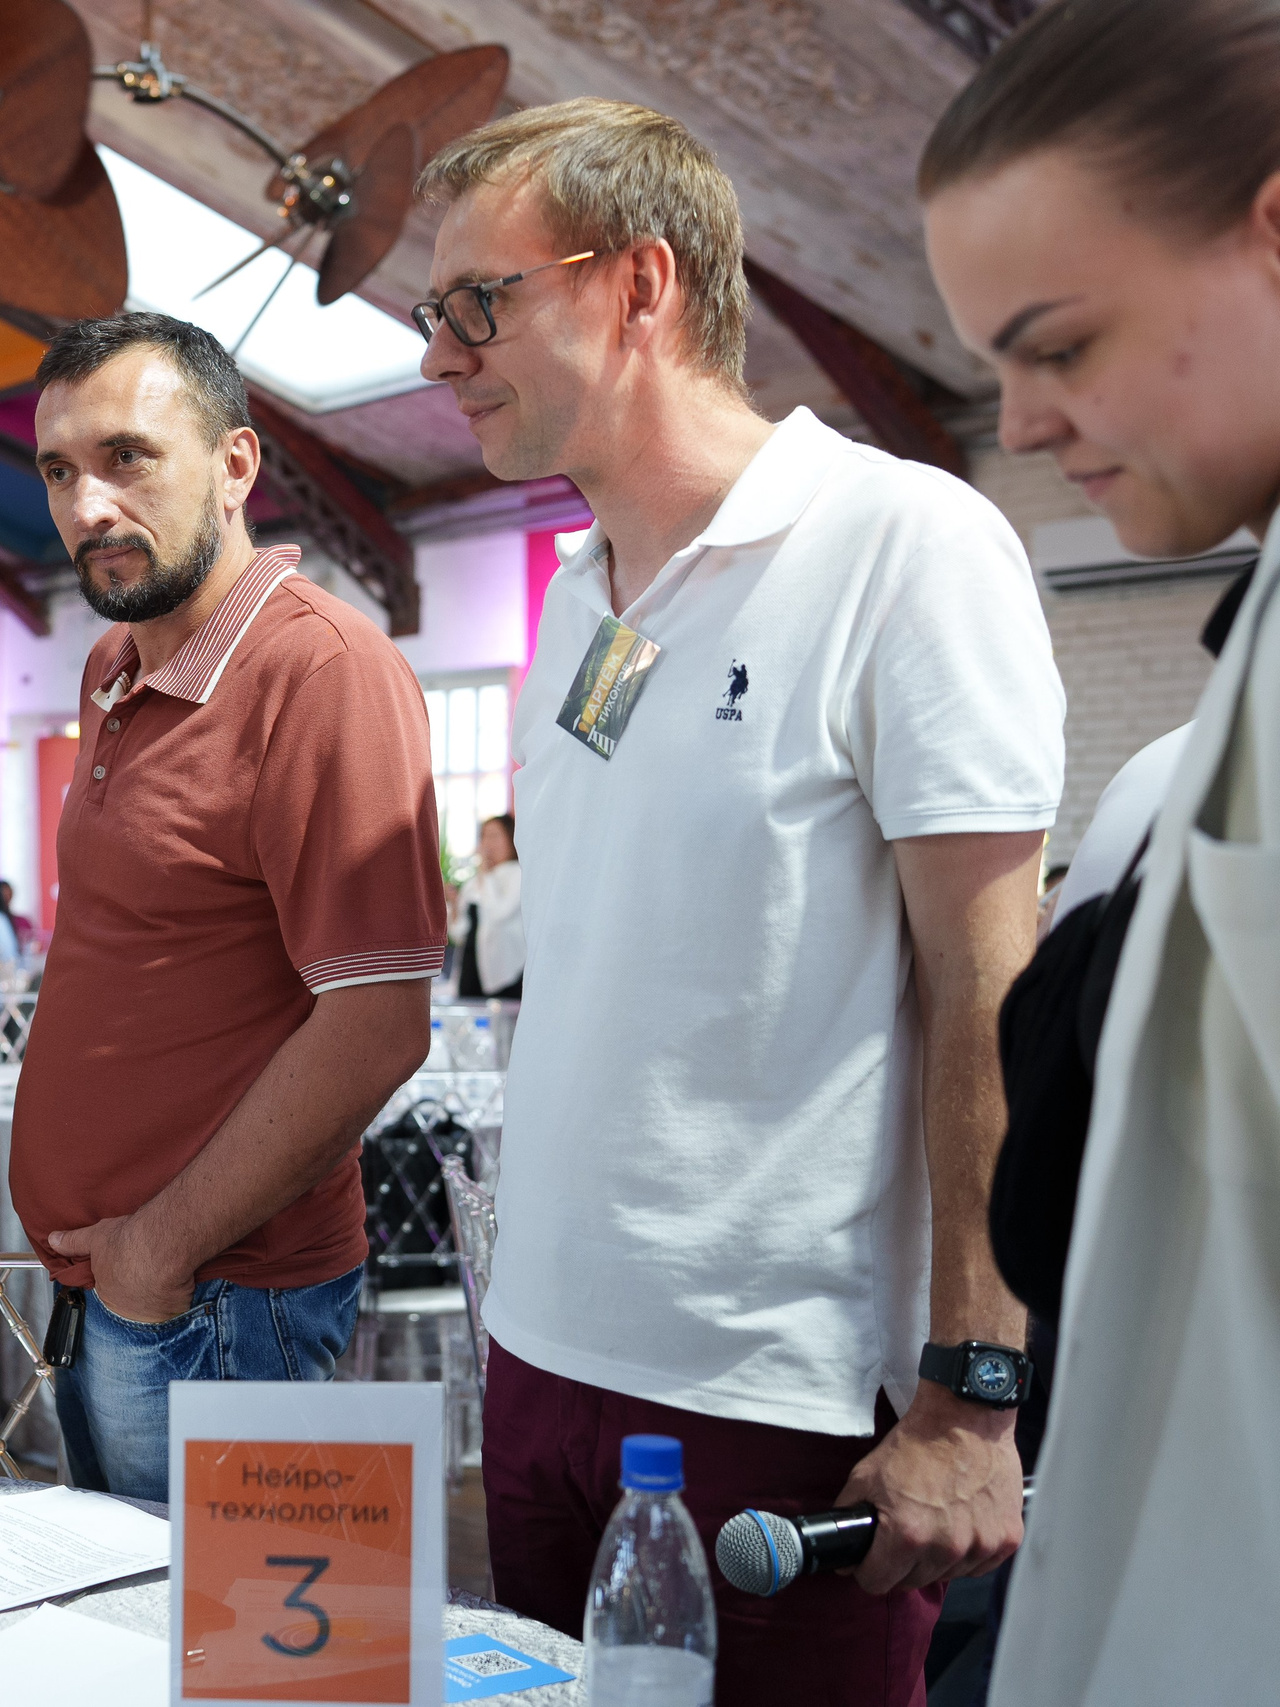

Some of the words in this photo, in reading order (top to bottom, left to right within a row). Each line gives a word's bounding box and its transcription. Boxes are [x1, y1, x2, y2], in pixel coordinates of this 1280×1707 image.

[586, 653, 621, 718] АРТЁМ
[598, 661, 630, 724] ТИХОНОВ
[715, 707, 742, 721] USPA
[242, 1462, 355, 1491] Нейро-
[207, 1499, 389, 1524] технологии
[260, 1556, 331, 1658] 3
